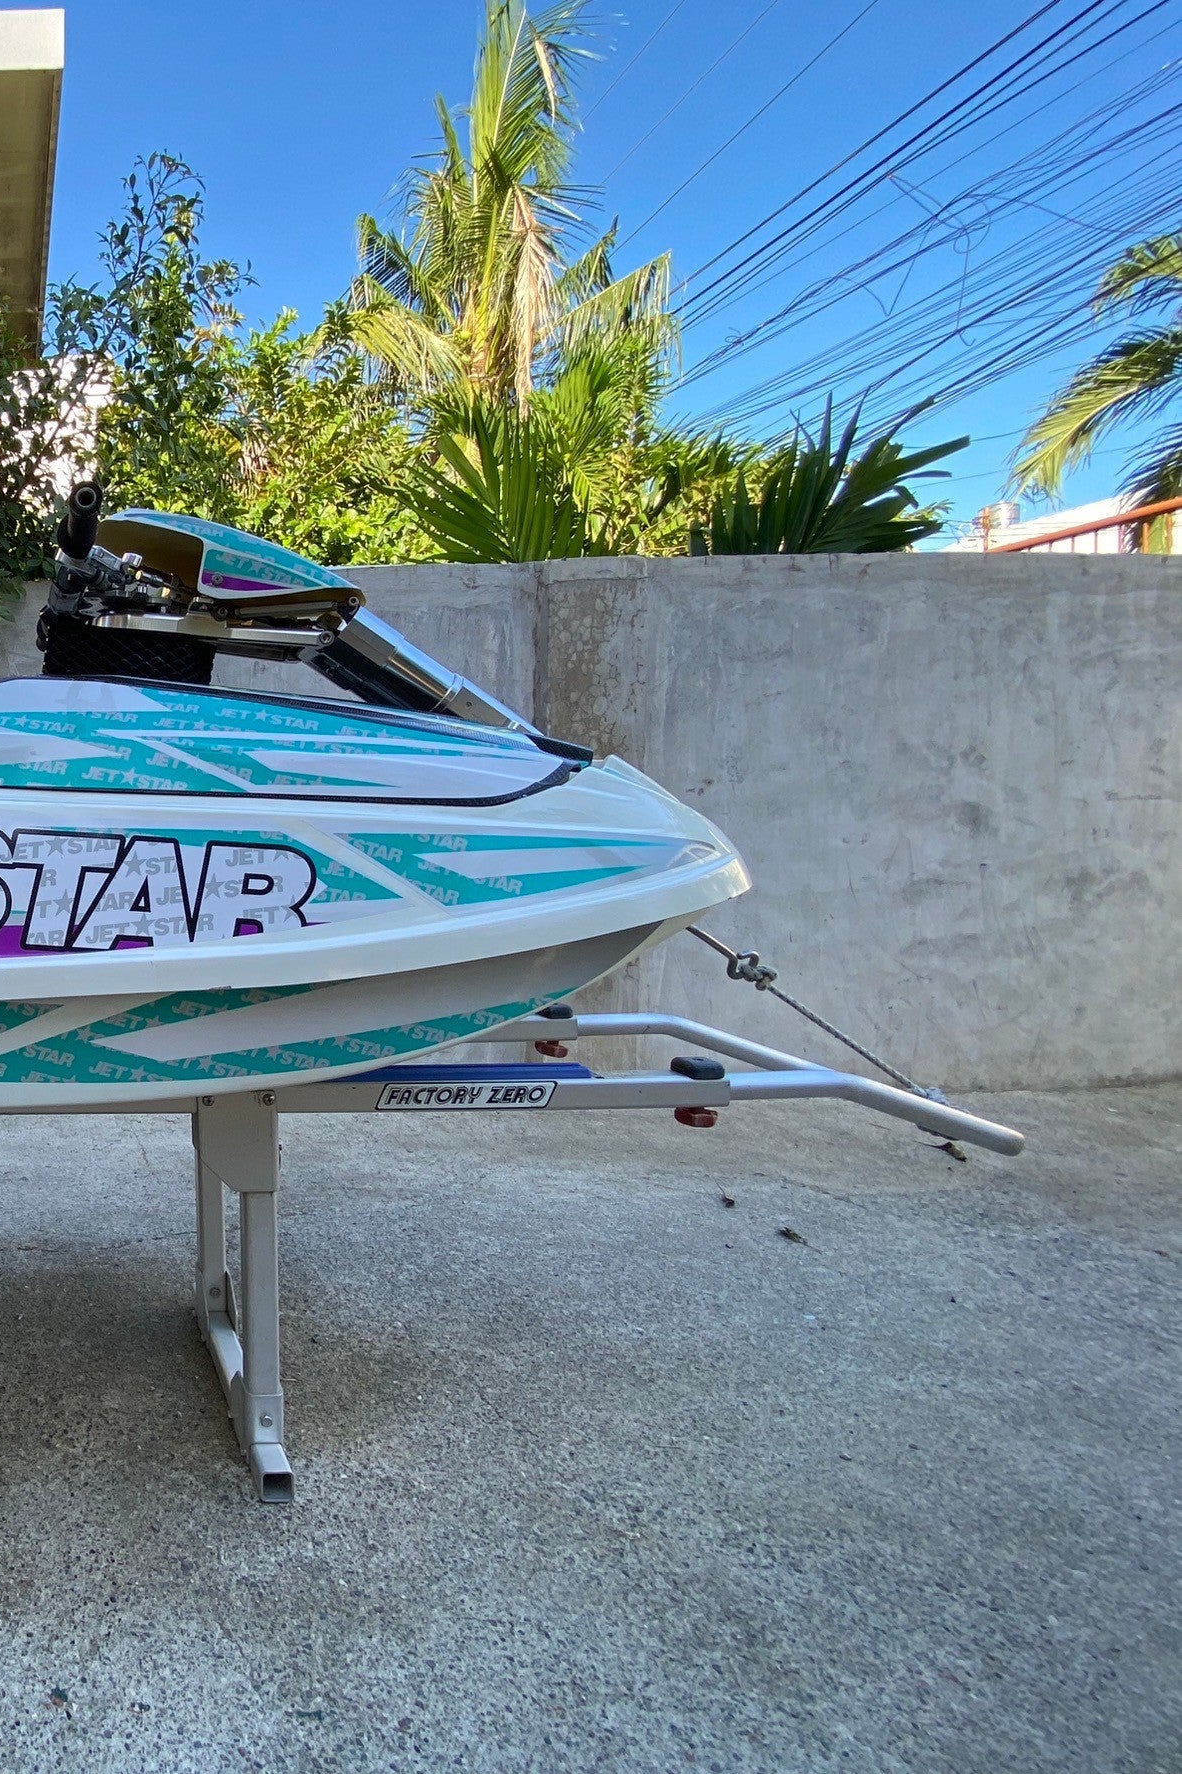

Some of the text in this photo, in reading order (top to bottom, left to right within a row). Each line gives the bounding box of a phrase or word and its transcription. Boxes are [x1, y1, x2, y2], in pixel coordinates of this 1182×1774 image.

[28, 719, 76, 734] STAR
[153, 718, 190, 730] JET
[215, 708, 319, 731] JET STAR
[81, 766, 189, 790] JET STAR
[225, 849, 265, 867] JET
[24, 1045, 76, 1068] STAR
[89, 1061, 129, 1080] JET
[384, 1085, 547, 1106] FACTORY ZERO
